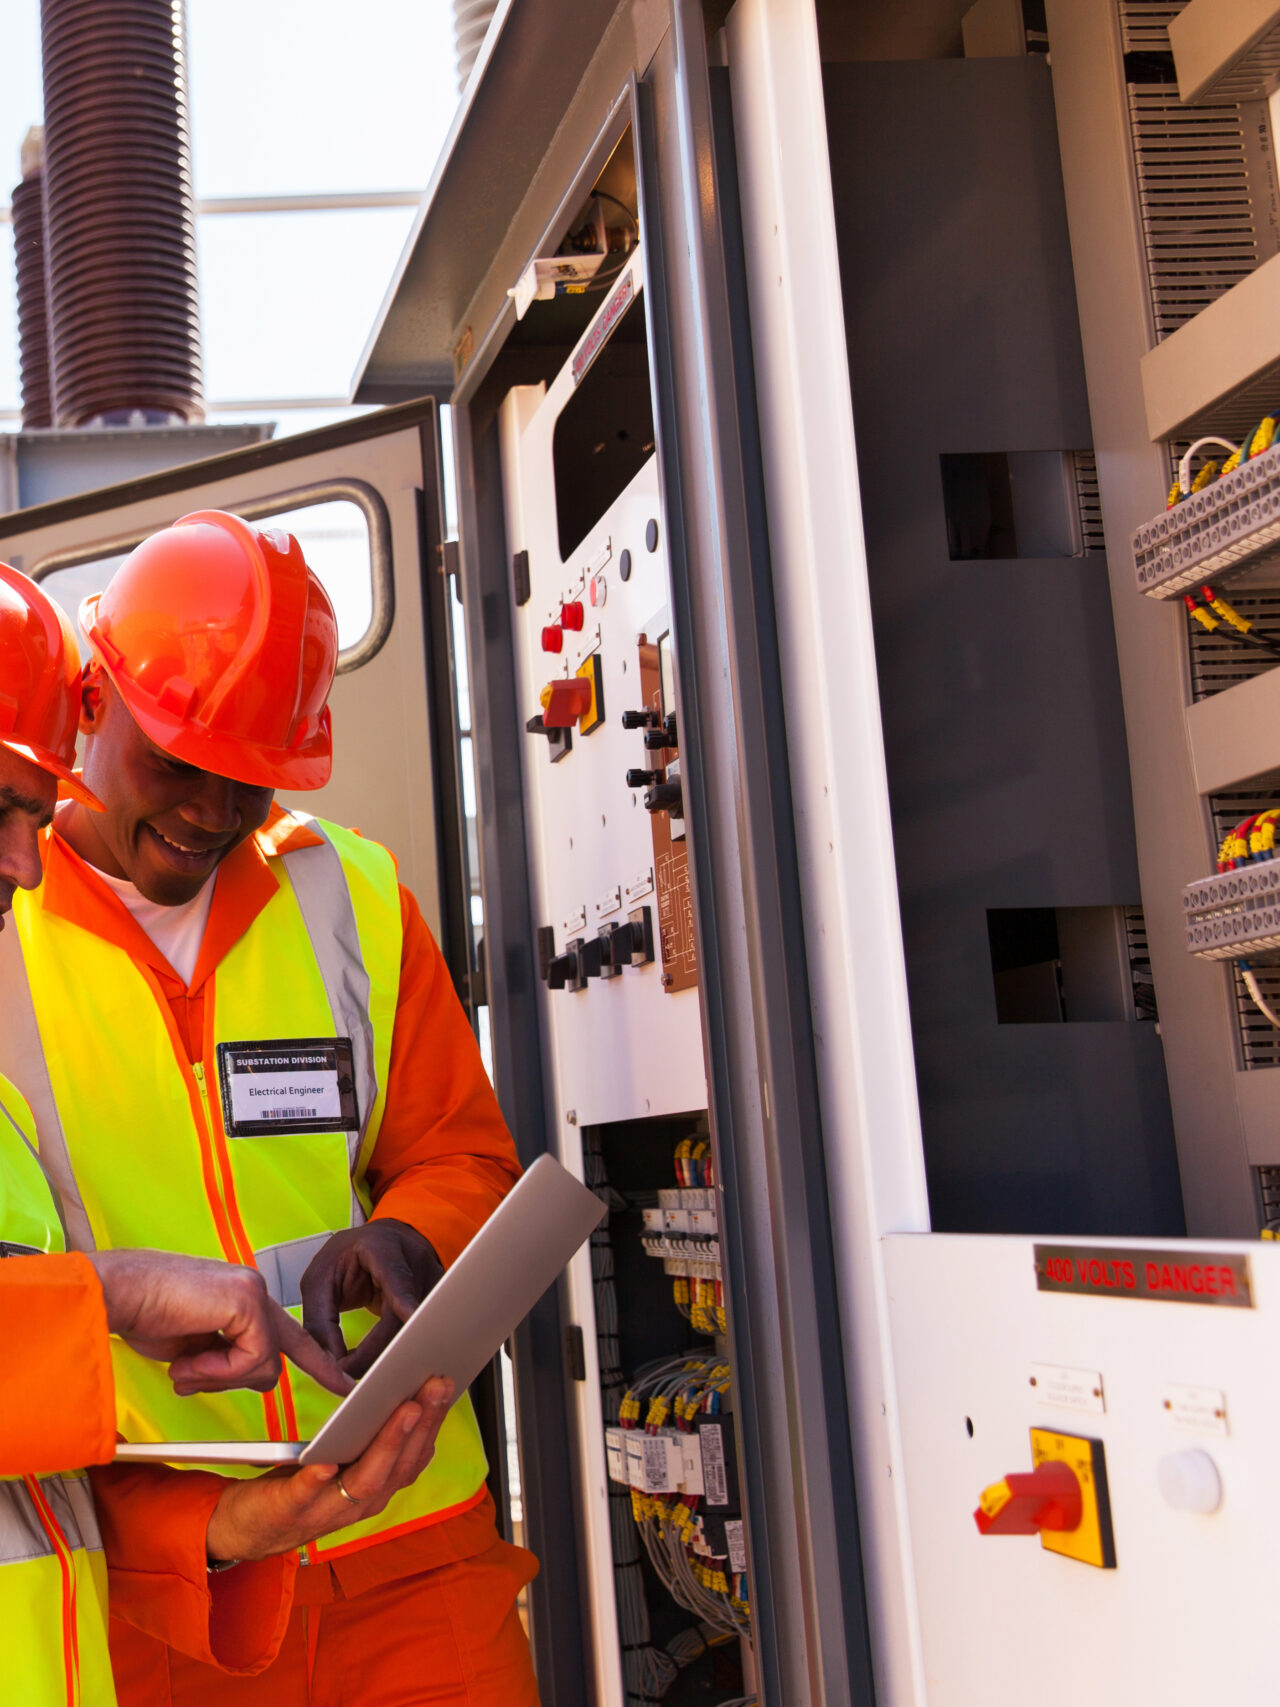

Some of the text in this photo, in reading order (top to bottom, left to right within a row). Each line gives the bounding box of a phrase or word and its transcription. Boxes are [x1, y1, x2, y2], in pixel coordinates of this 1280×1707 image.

[602, 284, 627, 331] DANGER
[236, 1056, 327, 1066] SUBSTATION DIVISION
[249, 1086, 324, 1097] Electrical Engineer
[1045, 1257, 1237, 1296] 400 VOLTS DANGER
